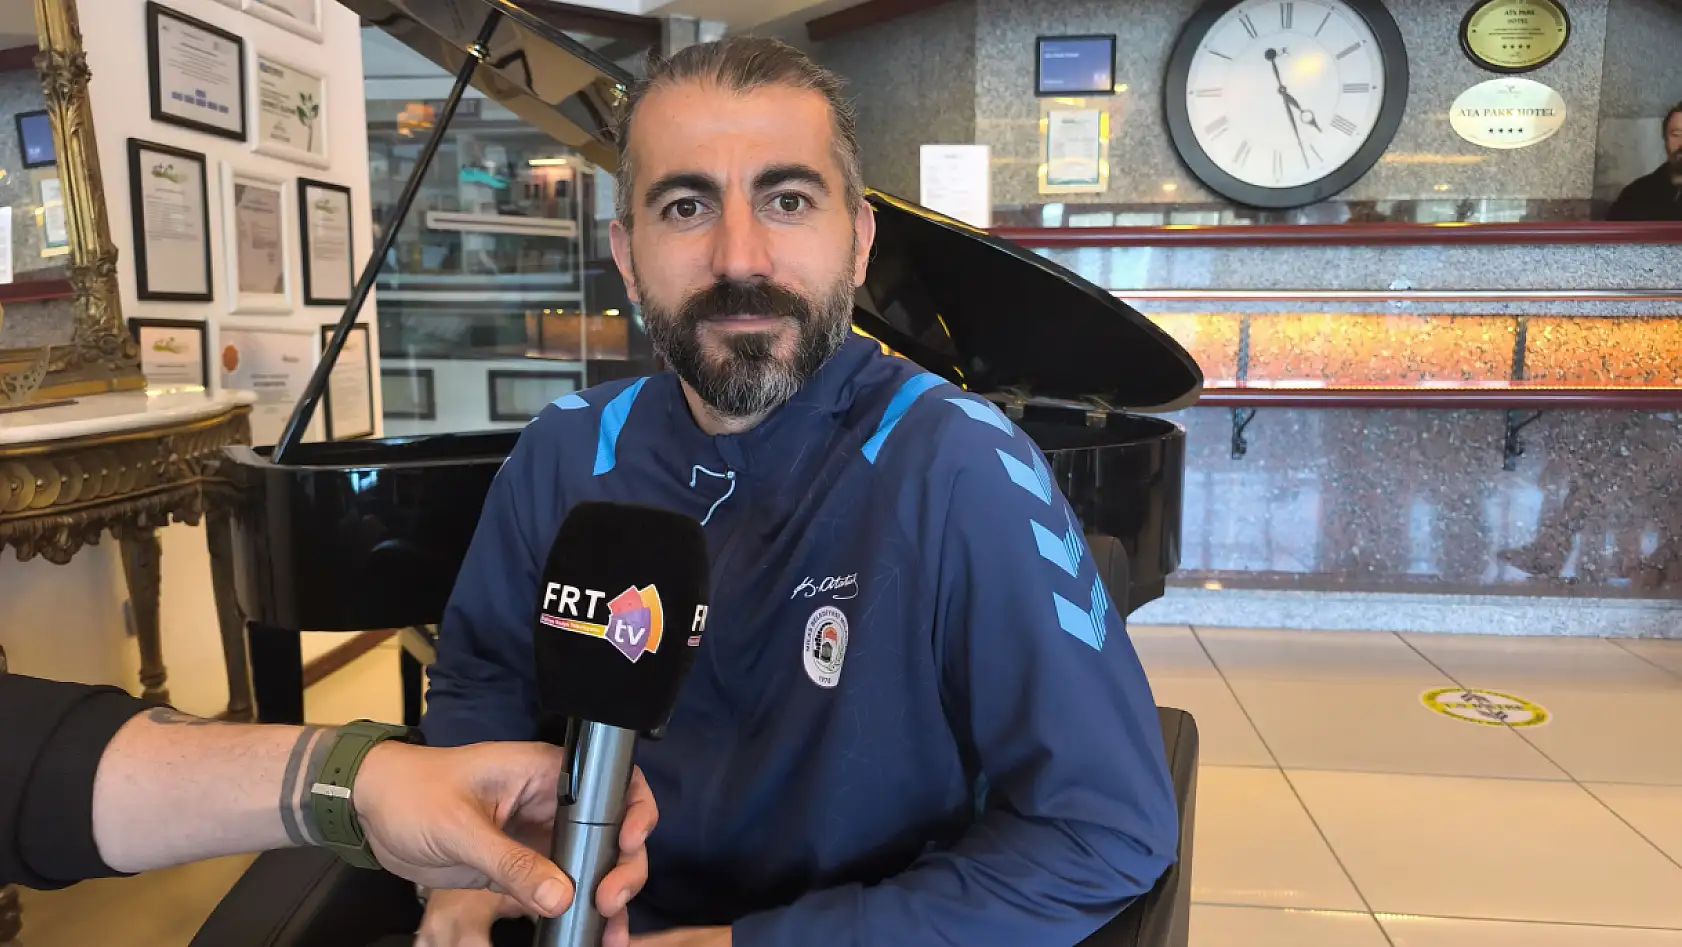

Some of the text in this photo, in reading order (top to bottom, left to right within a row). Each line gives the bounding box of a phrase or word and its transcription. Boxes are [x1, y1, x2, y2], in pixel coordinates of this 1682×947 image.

[1458, 108, 1556, 117] ATA PARK HOTEL
[543, 582, 606, 619] FRT
[614, 619, 646, 646] tv
